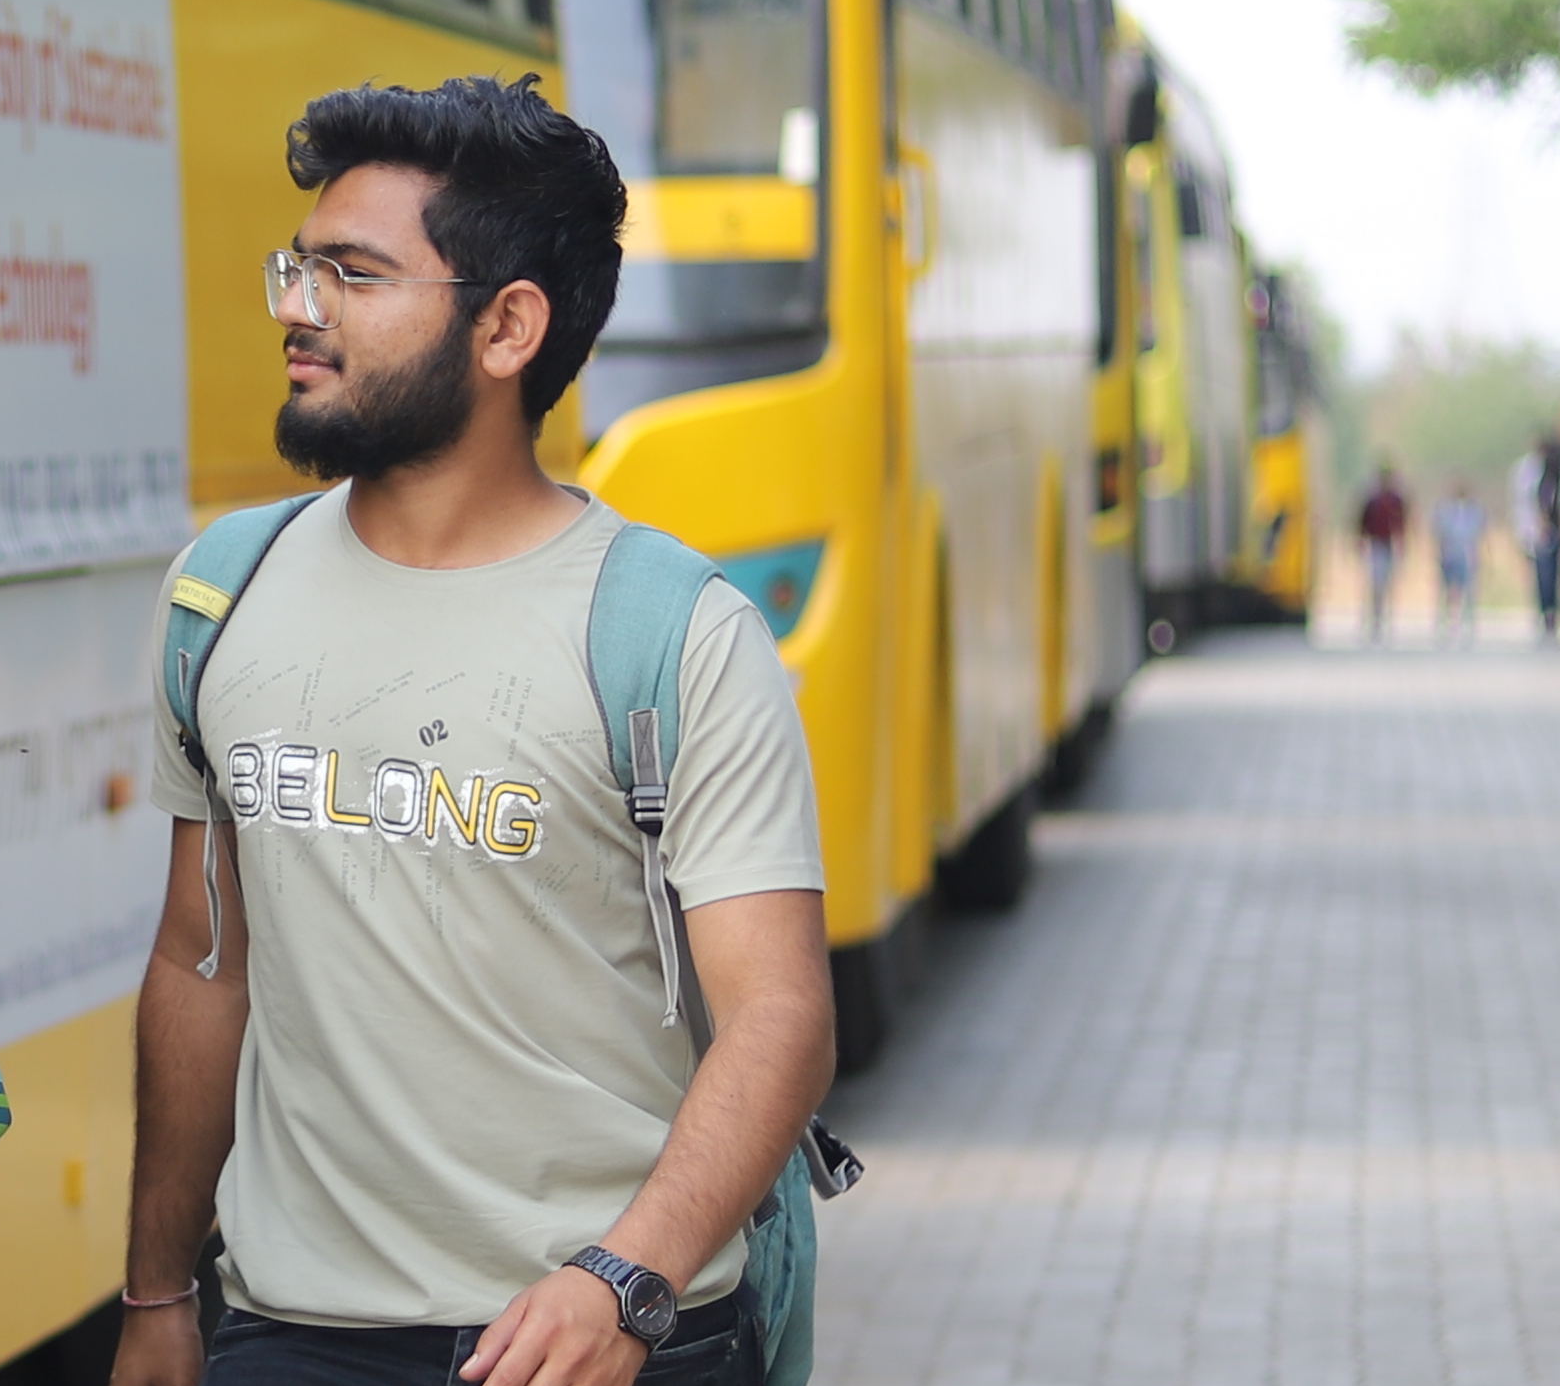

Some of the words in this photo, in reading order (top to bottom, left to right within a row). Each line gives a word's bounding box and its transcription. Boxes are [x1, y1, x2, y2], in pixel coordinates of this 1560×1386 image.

[424, 670, 467, 695] PERHAPS
[485, 687, 500, 723] FINISH
[514, 703, 526, 733] NEVER
[418, 718, 450, 748] 02
[539, 729, 574, 741] CAREER
[227, 741, 543, 857] BELONG
[369, 865, 377, 901] CHANGE
